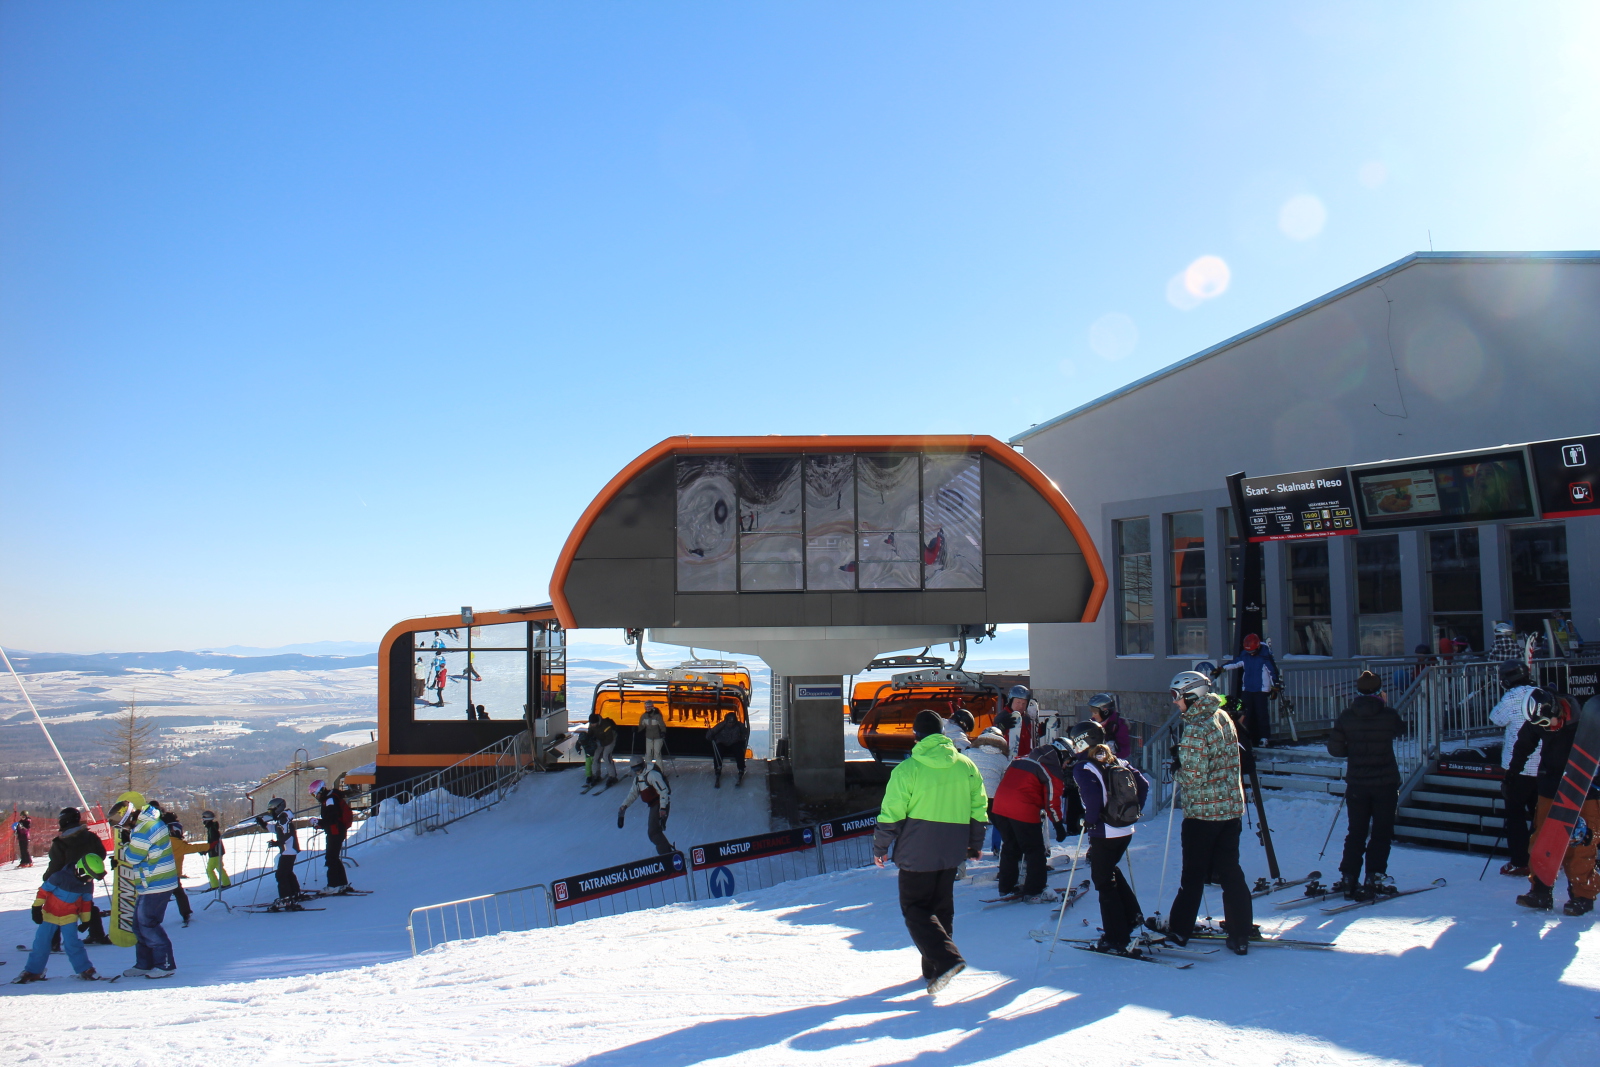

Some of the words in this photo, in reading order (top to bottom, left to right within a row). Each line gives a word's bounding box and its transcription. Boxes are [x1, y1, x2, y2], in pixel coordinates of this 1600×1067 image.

[1246, 485, 1269, 496] Štart
[1276, 480, 1316, 493] Skalnaté
[1316, 479, 1342, 489] Pleso
[1568, 672, 1598, 685] ATRANSKÁ
[841, 816, 878, 832] TATRANS
[719, 842, 751, 857] NÁSTUP
[752, 835, 791, 850] ENTRANCE
[579, 868, 629, 892] TATRANSKÁ
[629, 862, 665, 880] LOMNICA
[118, 864, 136, 934] BANANA
